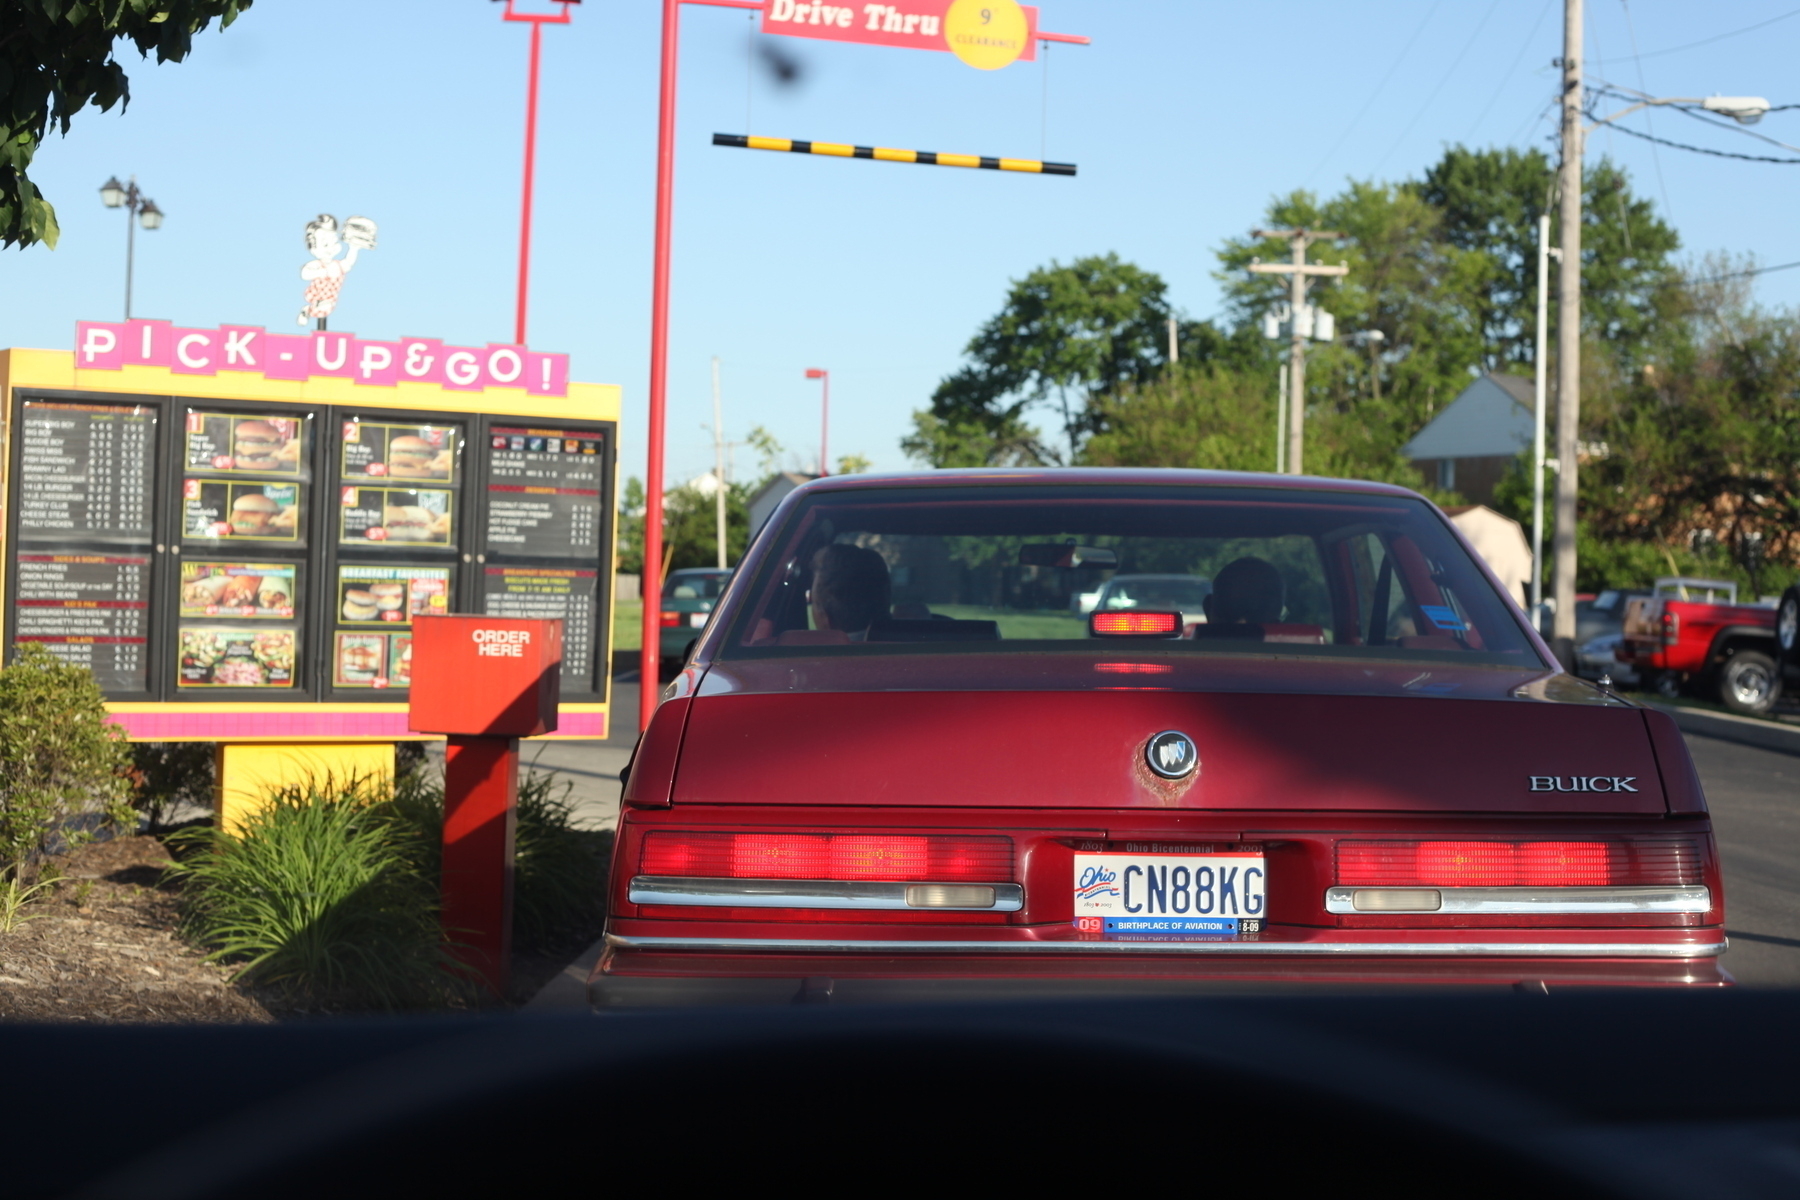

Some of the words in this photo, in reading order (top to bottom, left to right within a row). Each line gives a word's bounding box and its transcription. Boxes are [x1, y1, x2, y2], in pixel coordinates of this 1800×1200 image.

[770, 0, 853, 28] Drive
[864, 3, 940, 36] Thru
[956, 33, 1016, 49] CLEARANCE
[190, 415, 198, 431] 1
[344, 425, 356, 440] 2
[185, 481, 197, 499] 3
[342, 487, 355, 504] 4
[23, 501, 49, 509] TURKEY
[50, 502, 68, 510] CLUB
[20, 510, 46, 518] CHEESE
[48, 511, 70, 519] STEAK
[22, 519, 43, 527] PHILLY
[44, 520, 74, 528] CHICKEN
[488, 526, 506, 534] APPLE
[20, 563, 47, 571] FRENCH
[341, 567, 393, 578] BREAKFAST
[396, 568, 445, 579] FAVORITES
[43, 573, 64, 581] RINGS
[472, 629, 530, 645] ORDER
[478, 643, 523, 658] HERE
[70, 653, 92, 661] SALAD
[1529, 776, 1638, 792] BUICK
[1081, 841, 1103, 854] 1803
[1126, 843, 1147, 853] Ohio
[1152, 843, 1214, 853] Bicentennial
[1238, 845, 1263, 856] 2003
[1079, 865, 1116, 889] Ohio
[1124, 864, 1263, 915] CN88KG
[1079, 919, 1100, 930] 09
[1118, 922, 1169, 930] BIRTHPLACE
[1171, 922, 1182, 930] OF
[1185, 922, 1223, 930] AVIATION
[1242, 922, 1259, 932] 8-09
